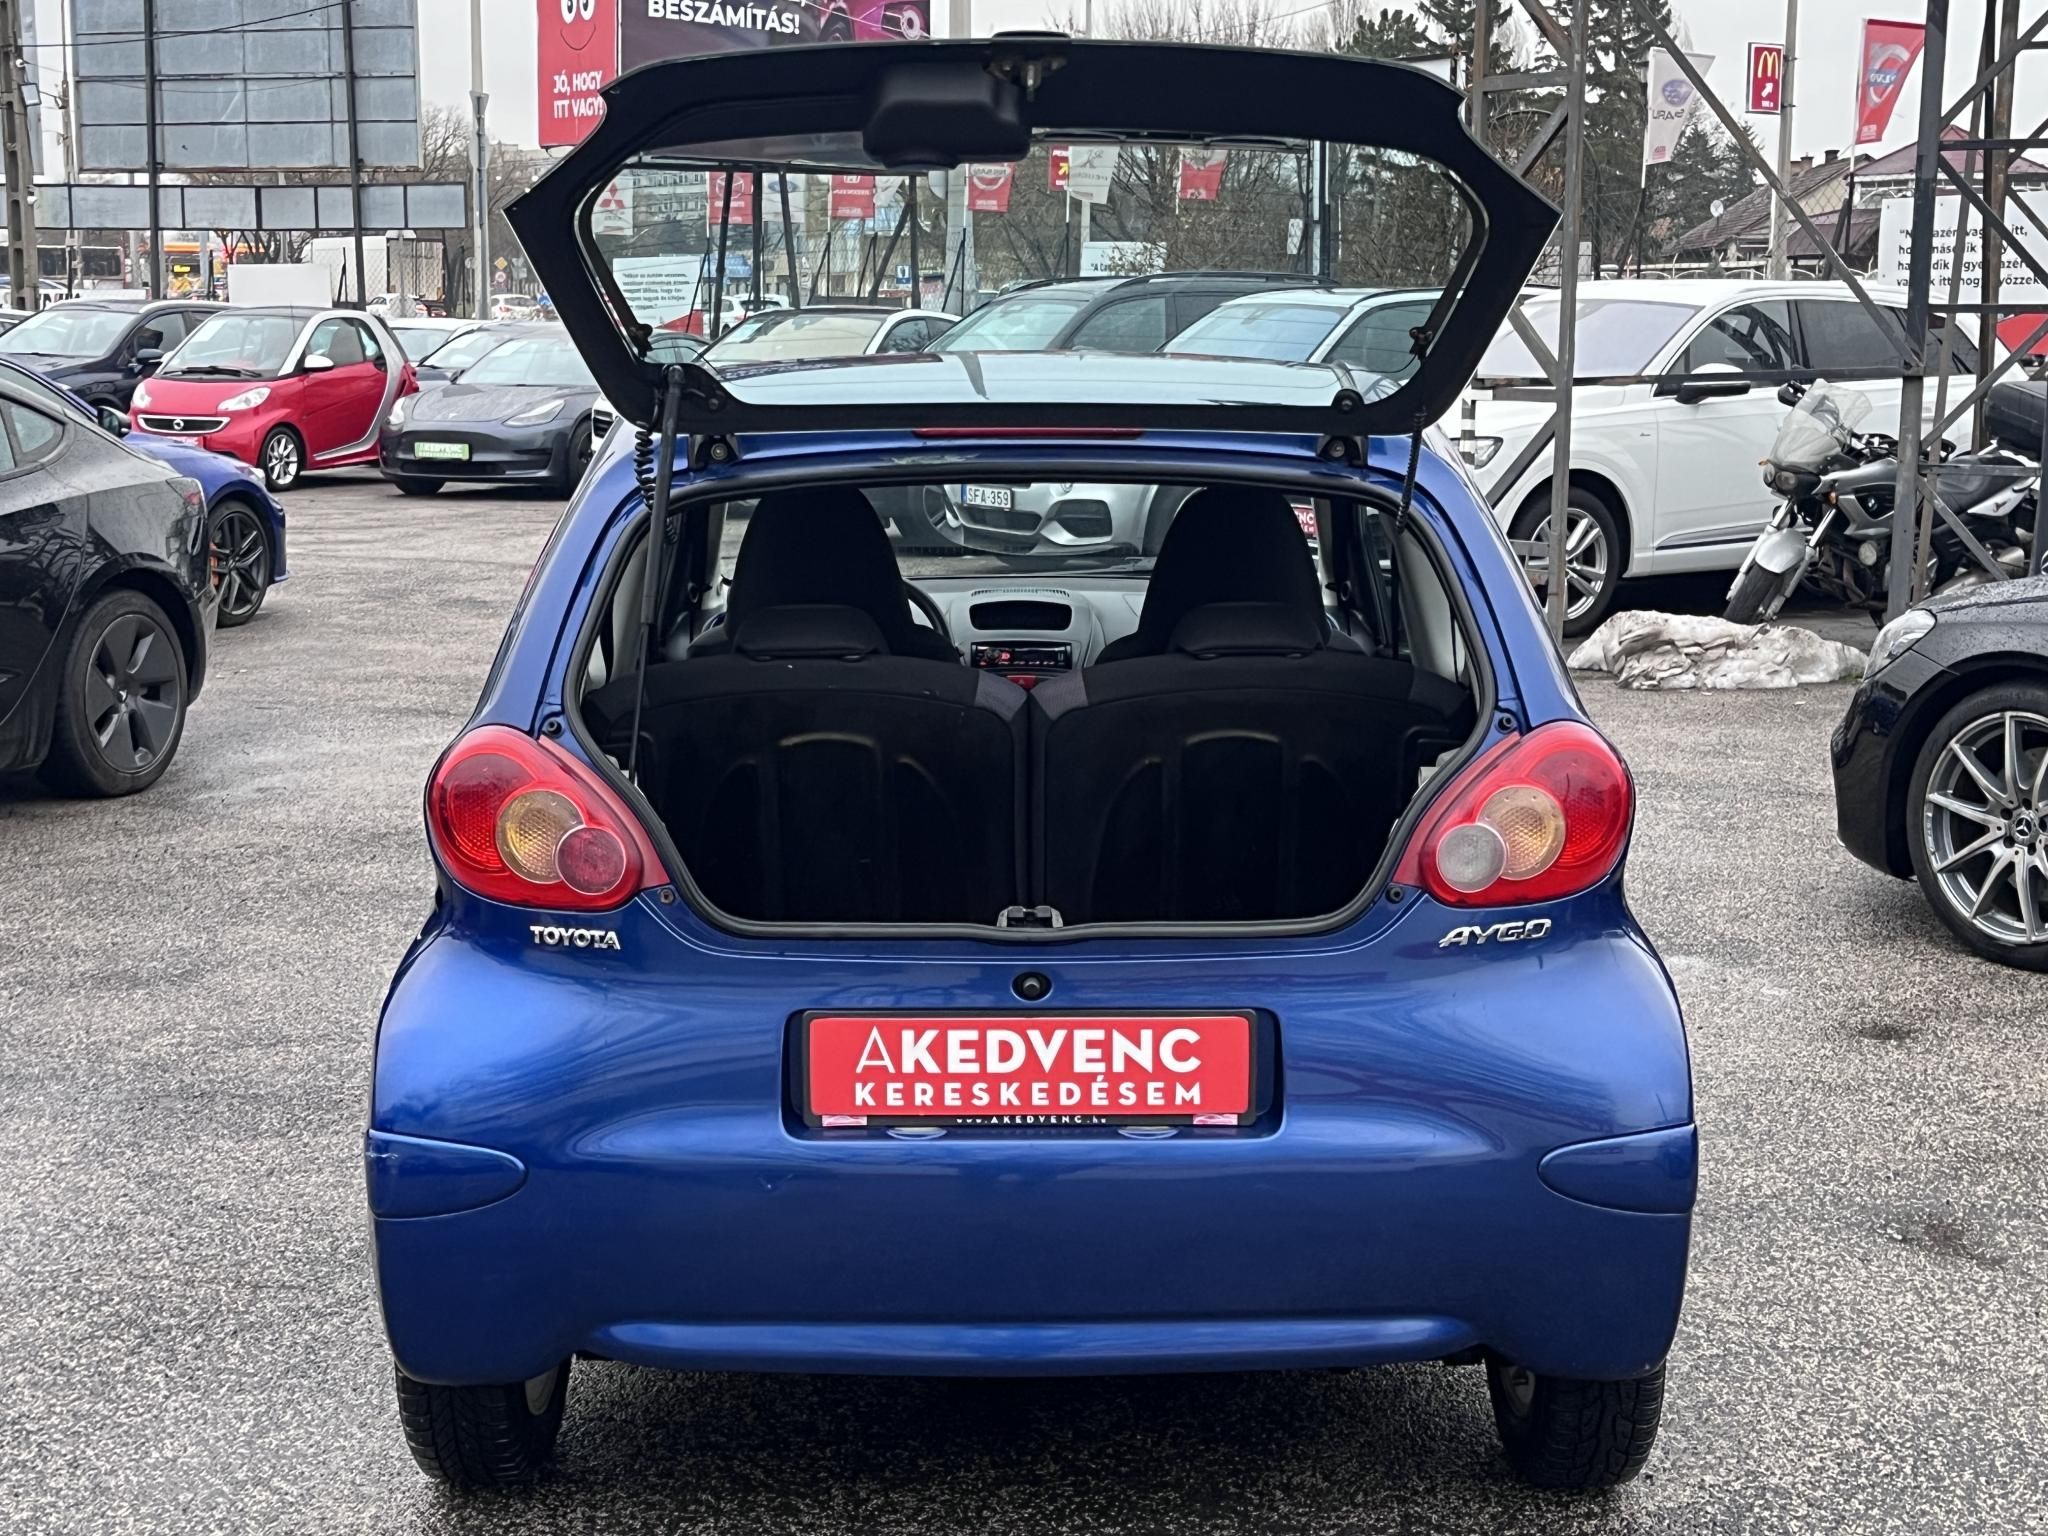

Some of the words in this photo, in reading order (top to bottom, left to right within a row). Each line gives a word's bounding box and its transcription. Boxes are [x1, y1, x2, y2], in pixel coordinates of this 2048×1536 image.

[648, 0, 800, 34] BESZÁMÍTÁS!
[553, 69, 570, 96] JÓ,
[572, 70, 602, 92] HOGY
[553, 99, 570, 119] ITT
[571, 95, 604, 118] VAGY!
[968, 488, 1009, 505] SFA-359
[529, 925, 621, 950] TOYOTA
[1438, 918, 1552, 948] AYGO
[854, 1075, 1202, 1107] KERESKEDÉSEM
